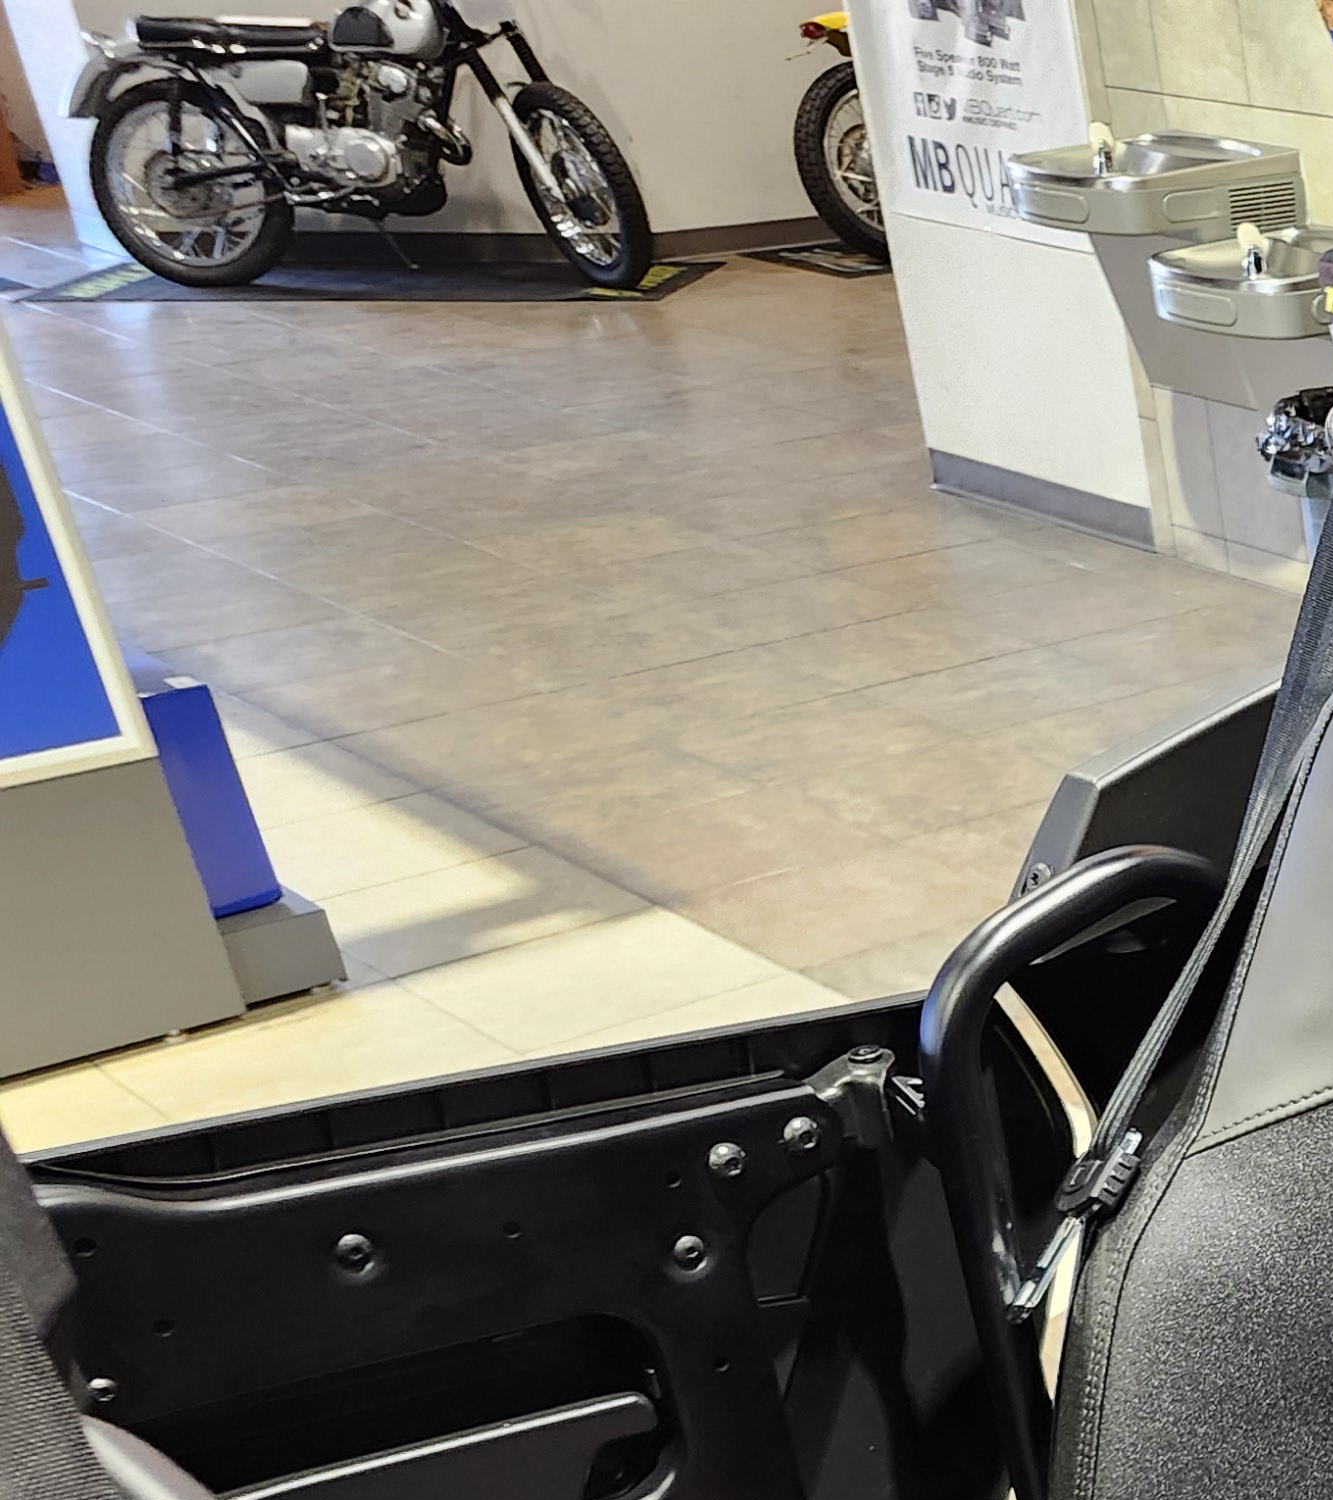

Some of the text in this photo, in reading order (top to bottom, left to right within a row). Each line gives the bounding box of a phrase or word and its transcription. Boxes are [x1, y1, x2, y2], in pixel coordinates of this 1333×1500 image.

[935, 49, 975, 66] Spear
[977, 56, 998, 69] 800
[999, 58, 1021, 72] Watt
[917, 60, 946, 77] Stage
[985, 70, 1023, 87] System
